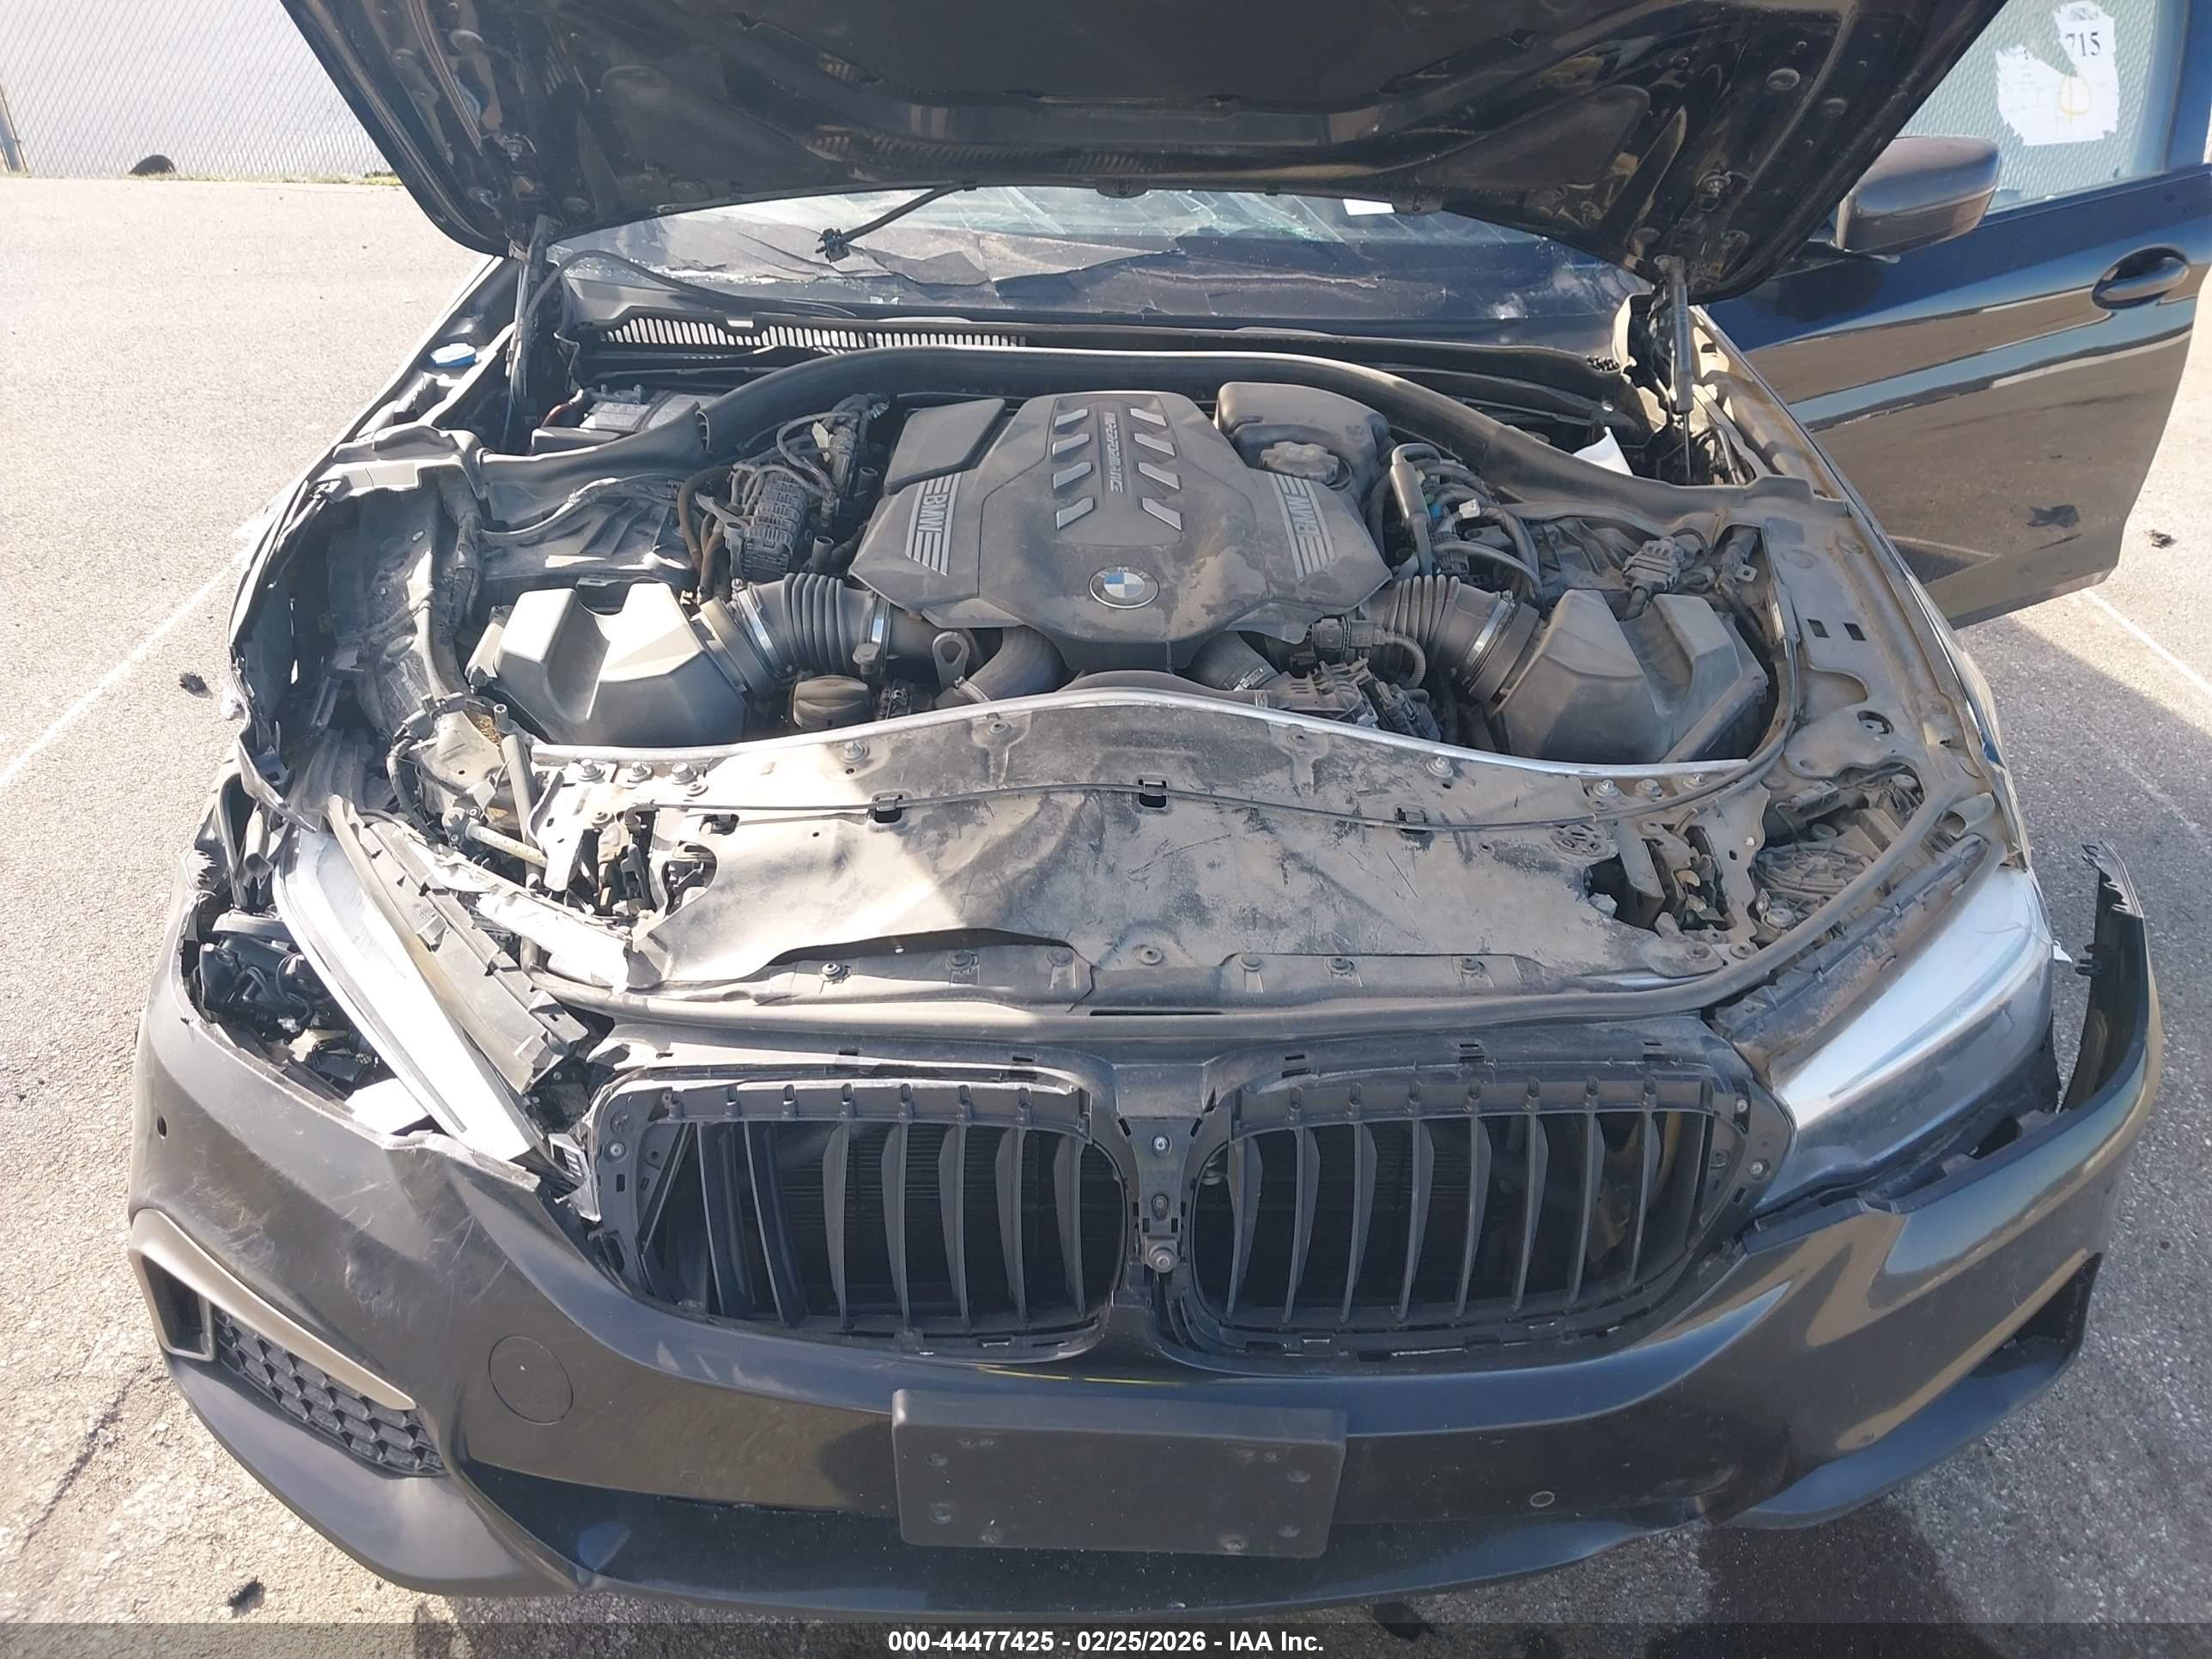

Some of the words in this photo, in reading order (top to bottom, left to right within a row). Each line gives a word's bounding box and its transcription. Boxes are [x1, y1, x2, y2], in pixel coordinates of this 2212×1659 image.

[2065, 31, 2101, 57] 715
[918, 494, 949, 532] BMW
[1285, 495, 1322, 535] BMW
